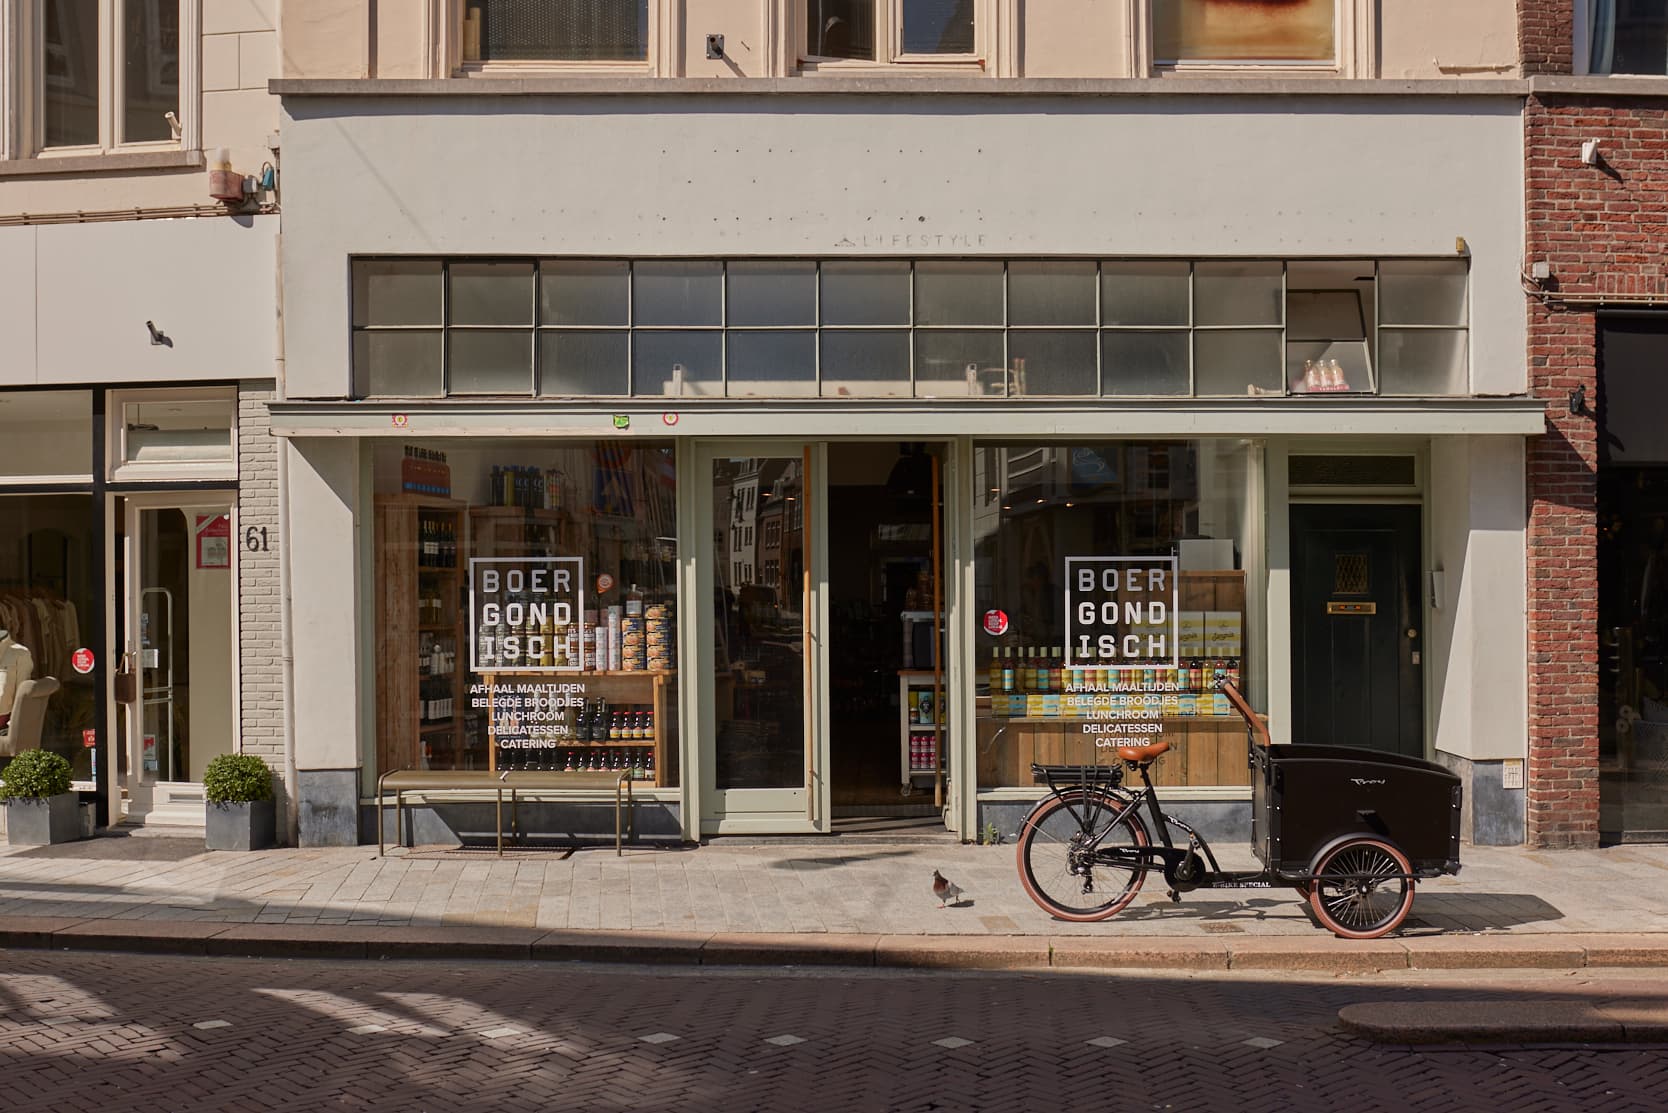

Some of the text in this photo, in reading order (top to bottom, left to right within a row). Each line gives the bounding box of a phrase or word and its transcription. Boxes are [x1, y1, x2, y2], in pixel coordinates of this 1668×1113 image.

[863, 233, 986, 248] LIFESTYLE
[246, 526, 269, 552] 61
[482, 569, 571, 593] BOER
[1078, 568, 1165, 592] BOER
[482, 602, 571, 626] GOND
[1078, 601, 1166, 625] GOND
[484, 636, 571, 659] ISCH
[1079, 634, 1165, 658] ISCH
[470, 683, 586, 694] AFHAAL MAALTIJDEN
[1065, 681, 1180, 692] AFHAAL MAALTIJDEN
[471, 697, 584, 708] BELEGDE BROODJES
[1067, 695, 1178, 706] BELEGDE BROODJES
[491, 711, 565, 721] LUNCHROOM
[1086, 710, 1159, 720] LUNCHROOM
[487, 725, 569, 735] DELICATESSEN
[1082, 724, 1163, 734] DELICATESSEN
[500, 739, 557, 749] CATERING
[1095, 737, 1151, 748] CATERING
